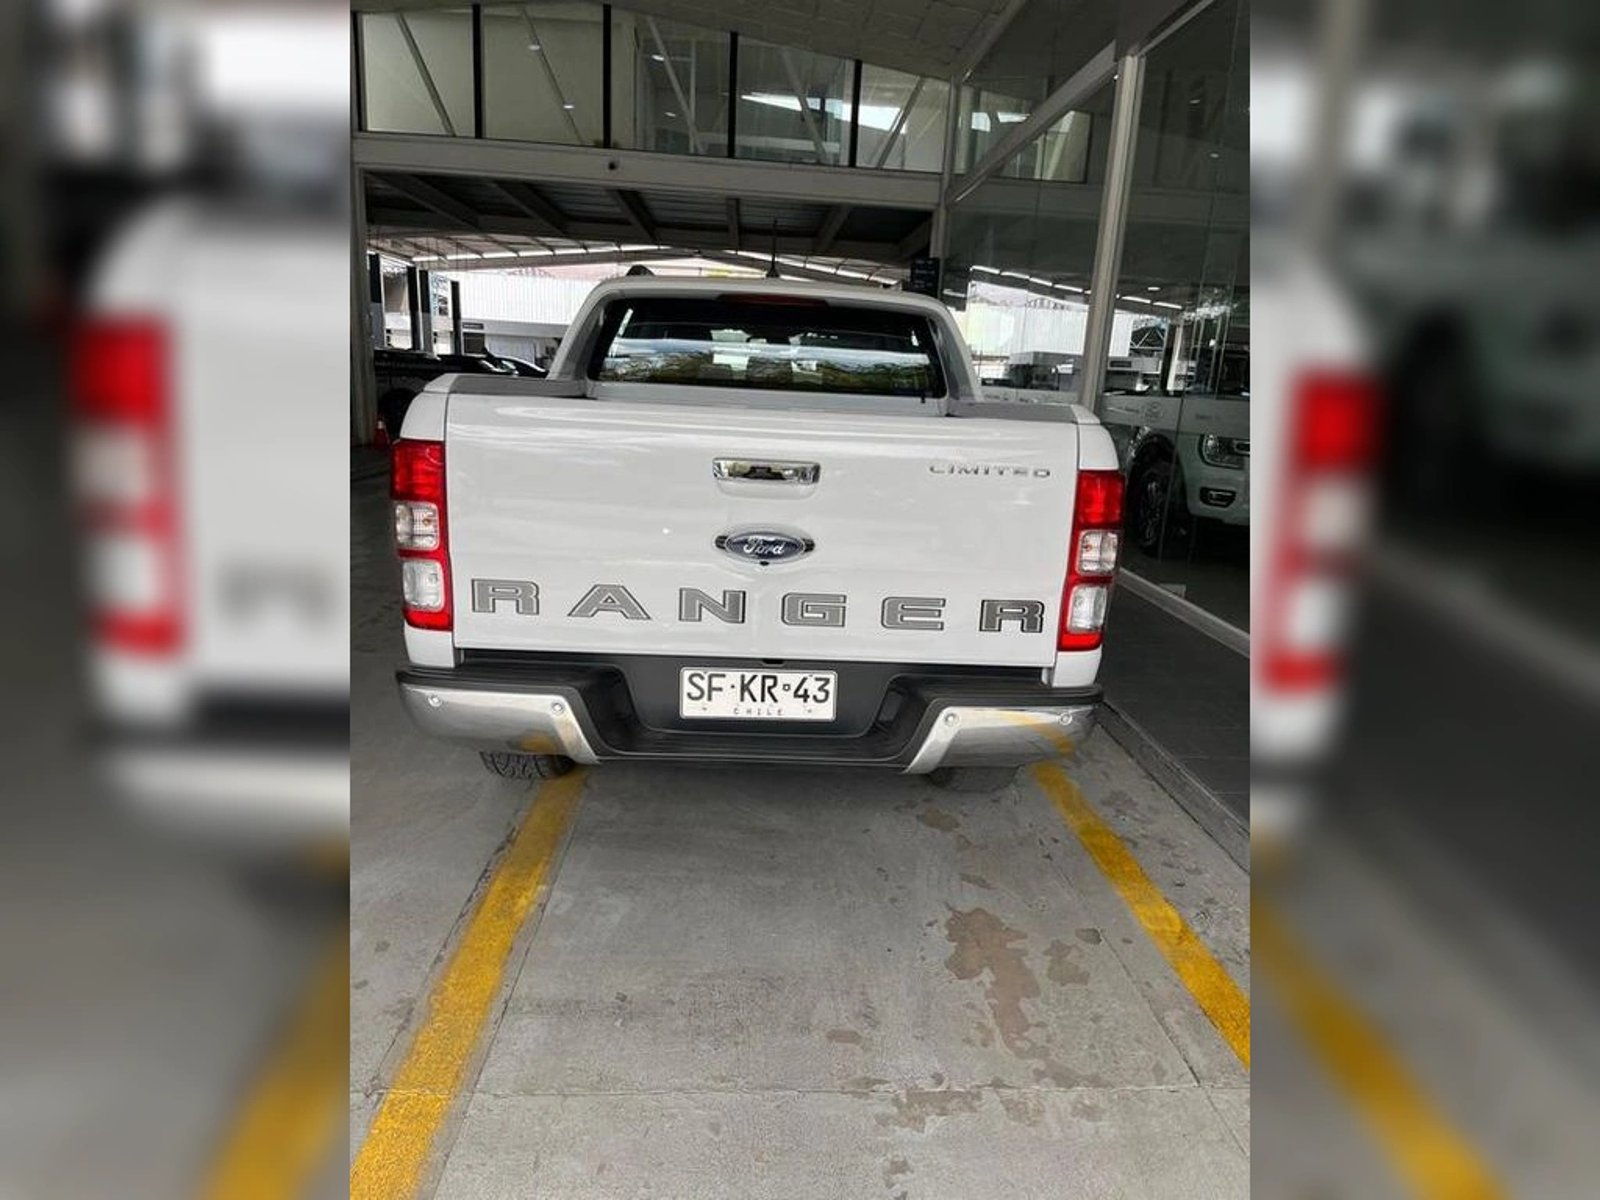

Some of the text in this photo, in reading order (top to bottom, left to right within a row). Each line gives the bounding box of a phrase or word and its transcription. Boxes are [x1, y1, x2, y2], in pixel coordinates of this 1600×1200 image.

[929, 463, 1051, 478] LIMITED
[743, 535, 785, 555] Ford
[471, 578, 1045, 632] RANGER
[733, 707, 784, 716] CHILE
